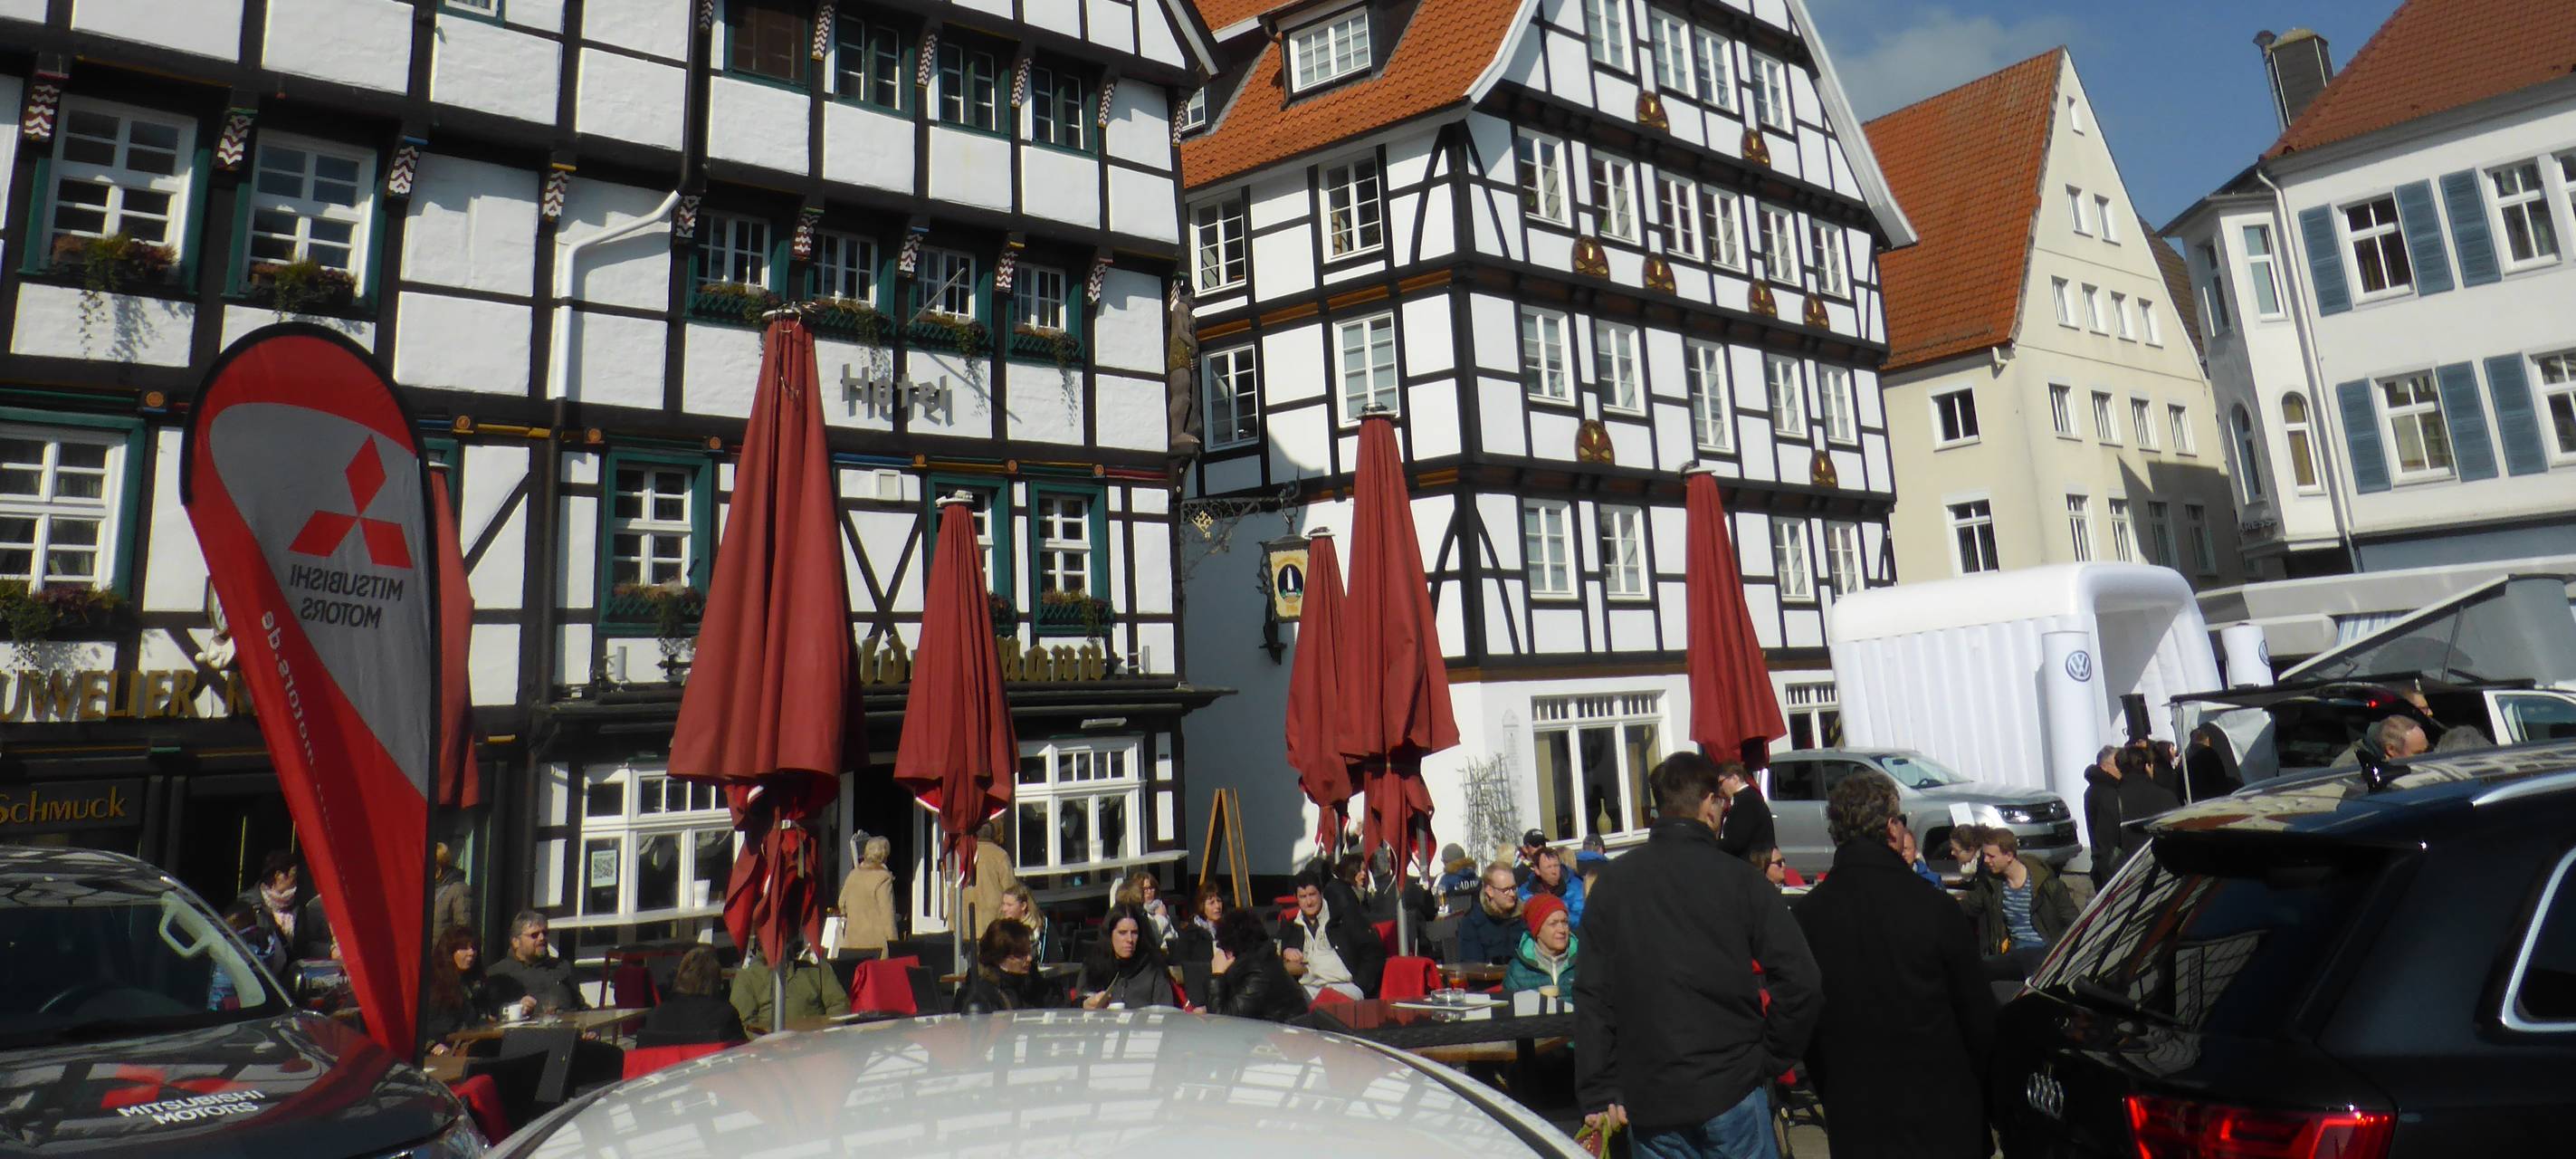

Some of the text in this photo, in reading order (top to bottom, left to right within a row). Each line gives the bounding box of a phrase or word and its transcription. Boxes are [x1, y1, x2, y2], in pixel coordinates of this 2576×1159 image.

[841, 363, 947, 414] Hotel
[117, 1089, 266, 1117] MITSUBISHI
[152, 1101, 259, 1125] MOTORS
